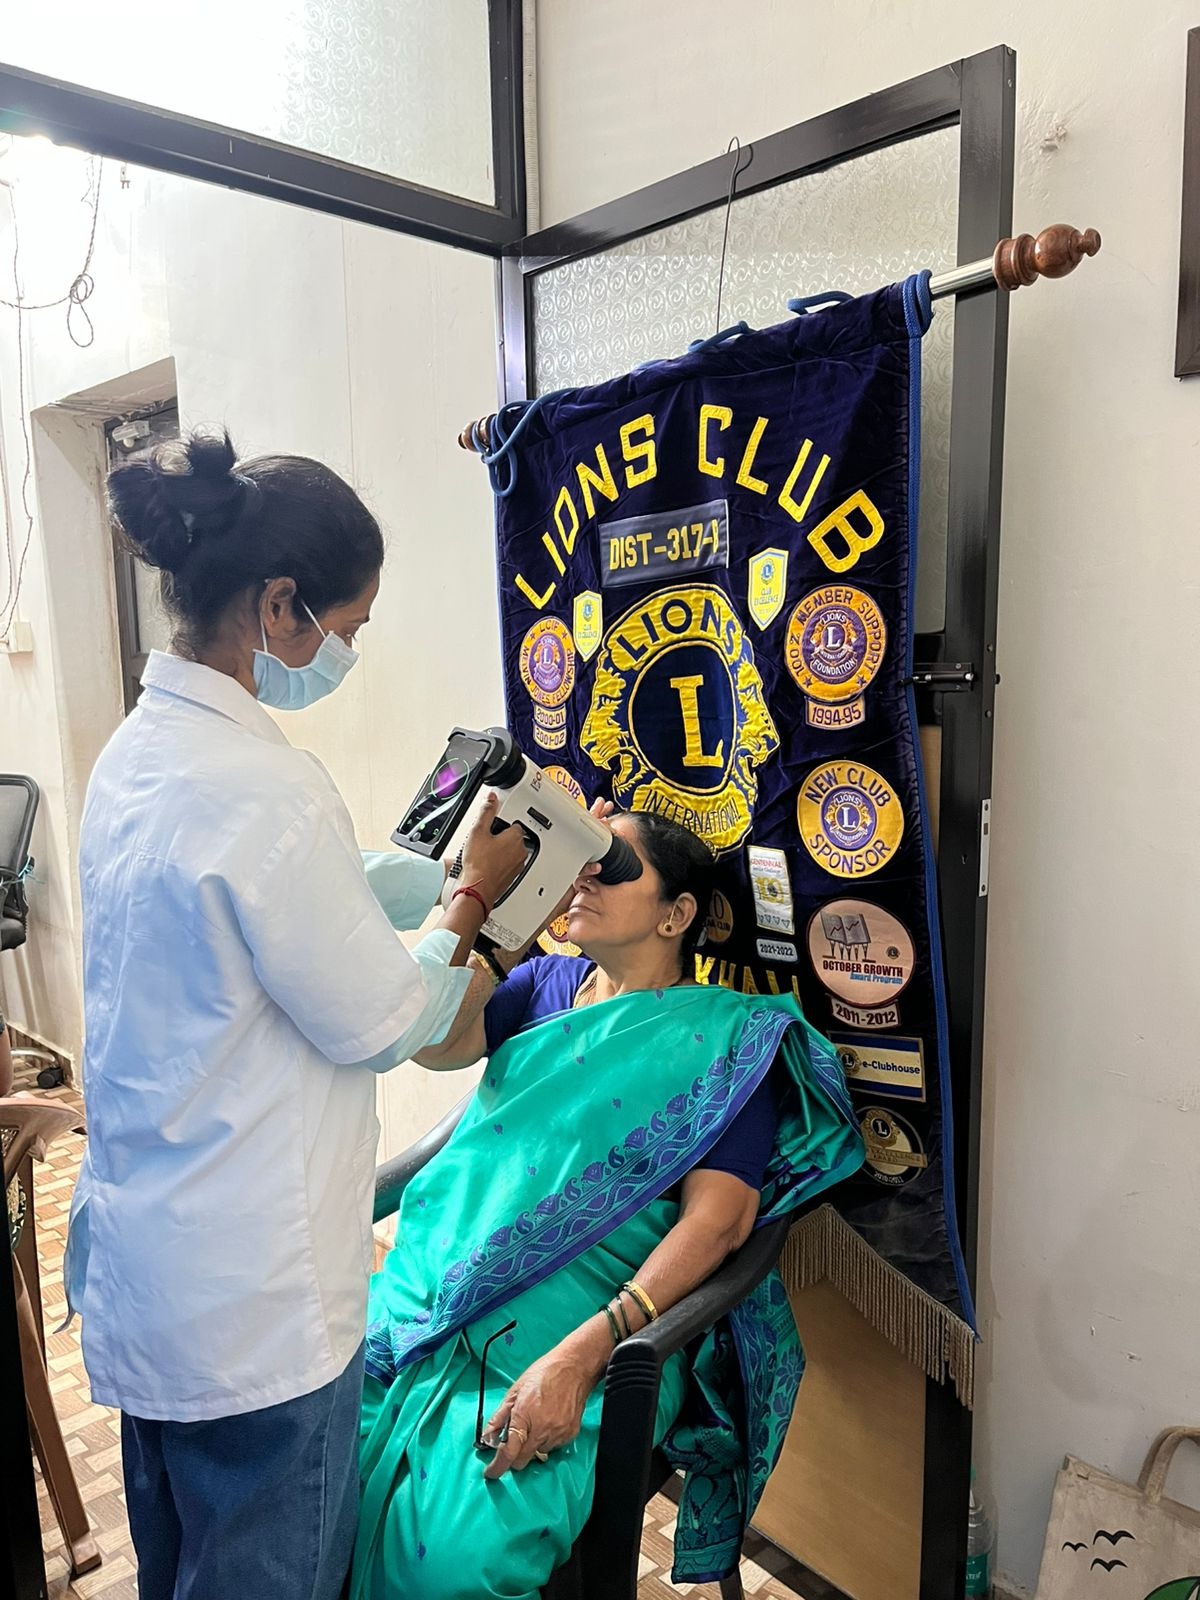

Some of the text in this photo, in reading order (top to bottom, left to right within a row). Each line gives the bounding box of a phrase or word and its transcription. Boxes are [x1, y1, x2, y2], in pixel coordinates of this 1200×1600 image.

[514, 404, 885, 609] LIONS CLUB
[540, 620, 560, 632] LCIF
[822, 612, 847, 625] LIONS
[616, 598, 737, 662] LIONS
[797, 589, 853, 625] MEMBER
[858, 600, 881, 675] SUPPORT
[826, 627, 840, 648] L
[813, 658, 857, 675] FOUNDATION
[536, 710, 564, 726] 2000-01
[670, 674, 724, 768] L
[812, 703, 861, 725] 1994-95
[536, 731, 565, 746] 2001-02
[556, 770, 580, 800] CLUB
[804, 767, 891, 807] NEW CLUB
[835, 793, 860, 805] LIONS
[841, 807, 856, 828] L
[809, 833, 891, 874] SPONSOR
[759, 944, 794, 957] 2021-2022
[823, 960, 903, 977] OCTOBER GROWTH
[835, 1003, 896, 1025] 2011-2012
[863, 1060, 920, 1074] e-Clubhouse
